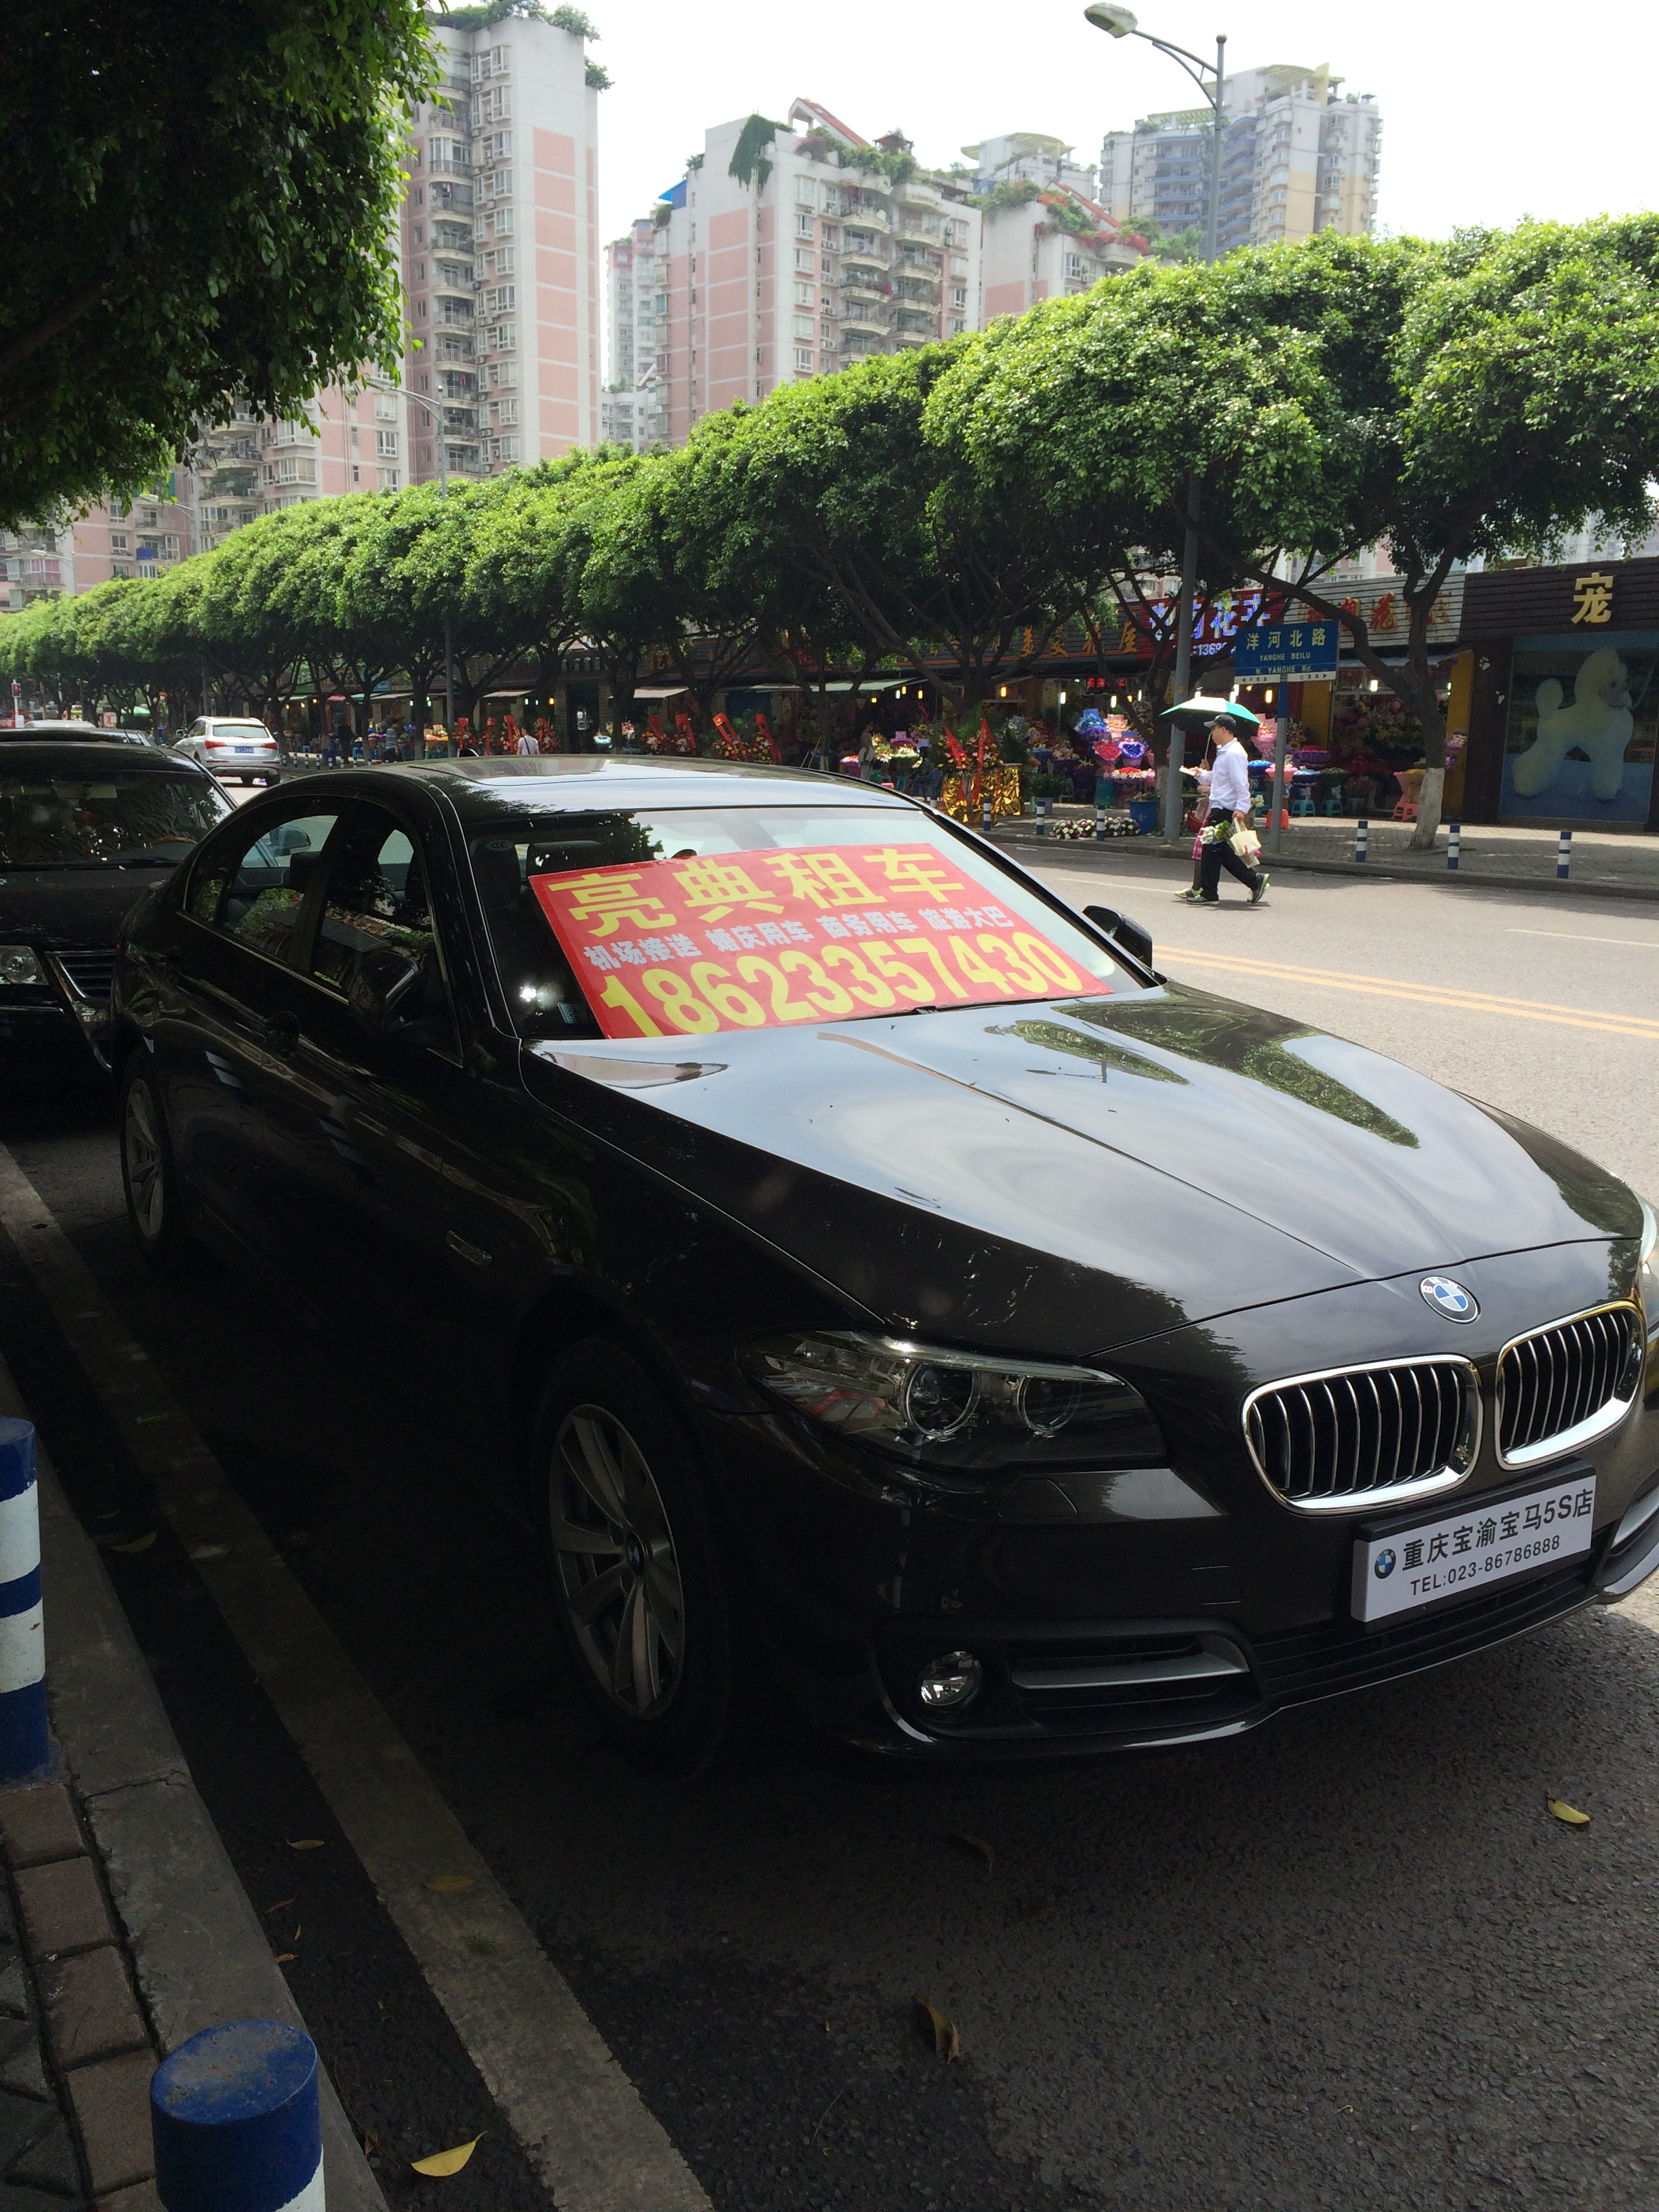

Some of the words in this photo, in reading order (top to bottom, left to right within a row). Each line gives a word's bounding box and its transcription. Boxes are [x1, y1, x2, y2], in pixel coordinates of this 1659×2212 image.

[1571, 572, 1614, 624] 宠
[1246, 628, 1326, 651] 洋河北路
[1259, 653, 1286, 661] YANGHE
[1291, 651, 1311, 659] BEILU
[1268, 665, 1296, 674] YANGHE
[548, 848, 965, 937] 亮典租车
[583, 933, 703, 971] 机场接送
[705, 920, 815, 952] 婚庆用车
[815, 910, 920, 939] 商务用车
[918, 905, 1015, 930] 旅游大巴
[600, 931, 1083, 1038] 18623357430
[1402, 1488, 1593, 1571] 重庆宝渝宝马5S店
[1410, 1535, 1560, 1595] TEL:023-86786888
